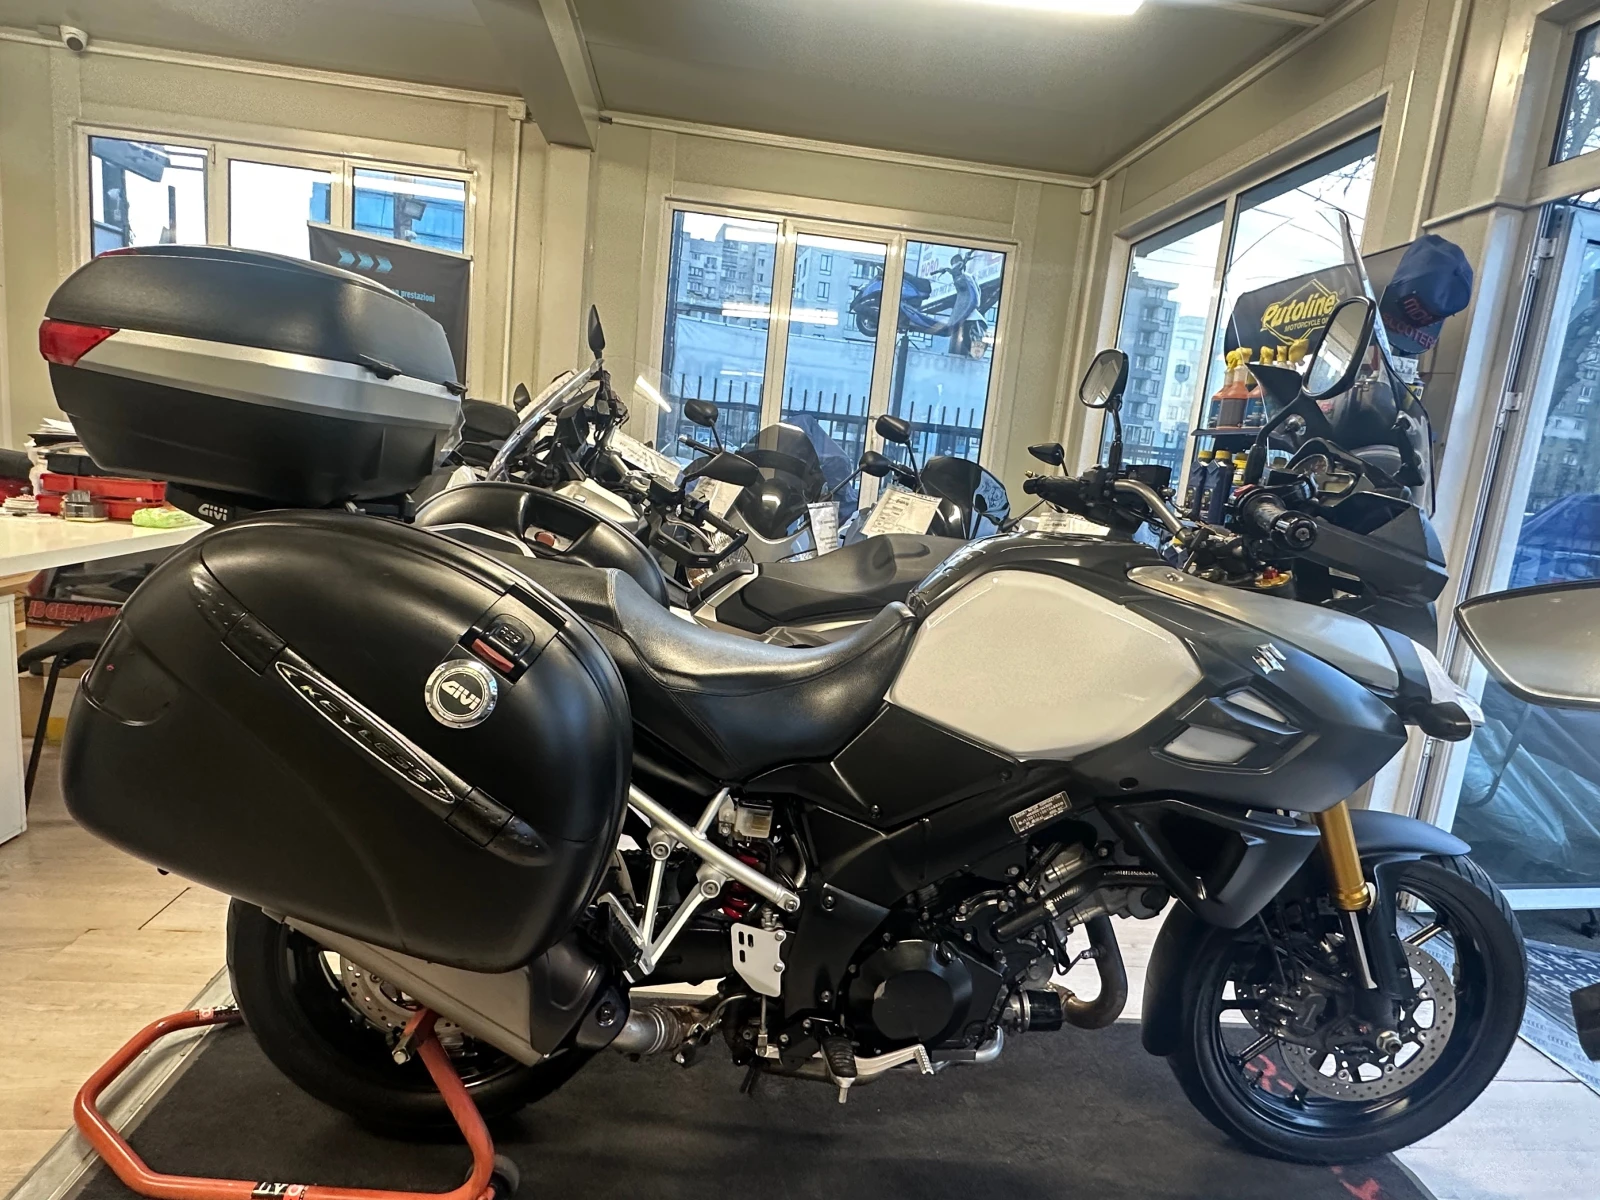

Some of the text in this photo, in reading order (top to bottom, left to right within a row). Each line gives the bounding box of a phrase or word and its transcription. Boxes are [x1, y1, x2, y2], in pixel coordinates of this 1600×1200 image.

[1261, 292, 1338, 330] Putoline
[1284, 319, 1321, 333] MOTORCYCLE
[441, 680, 481, 710] GIVI
[300, 685, 432, 783] KEYLESS
